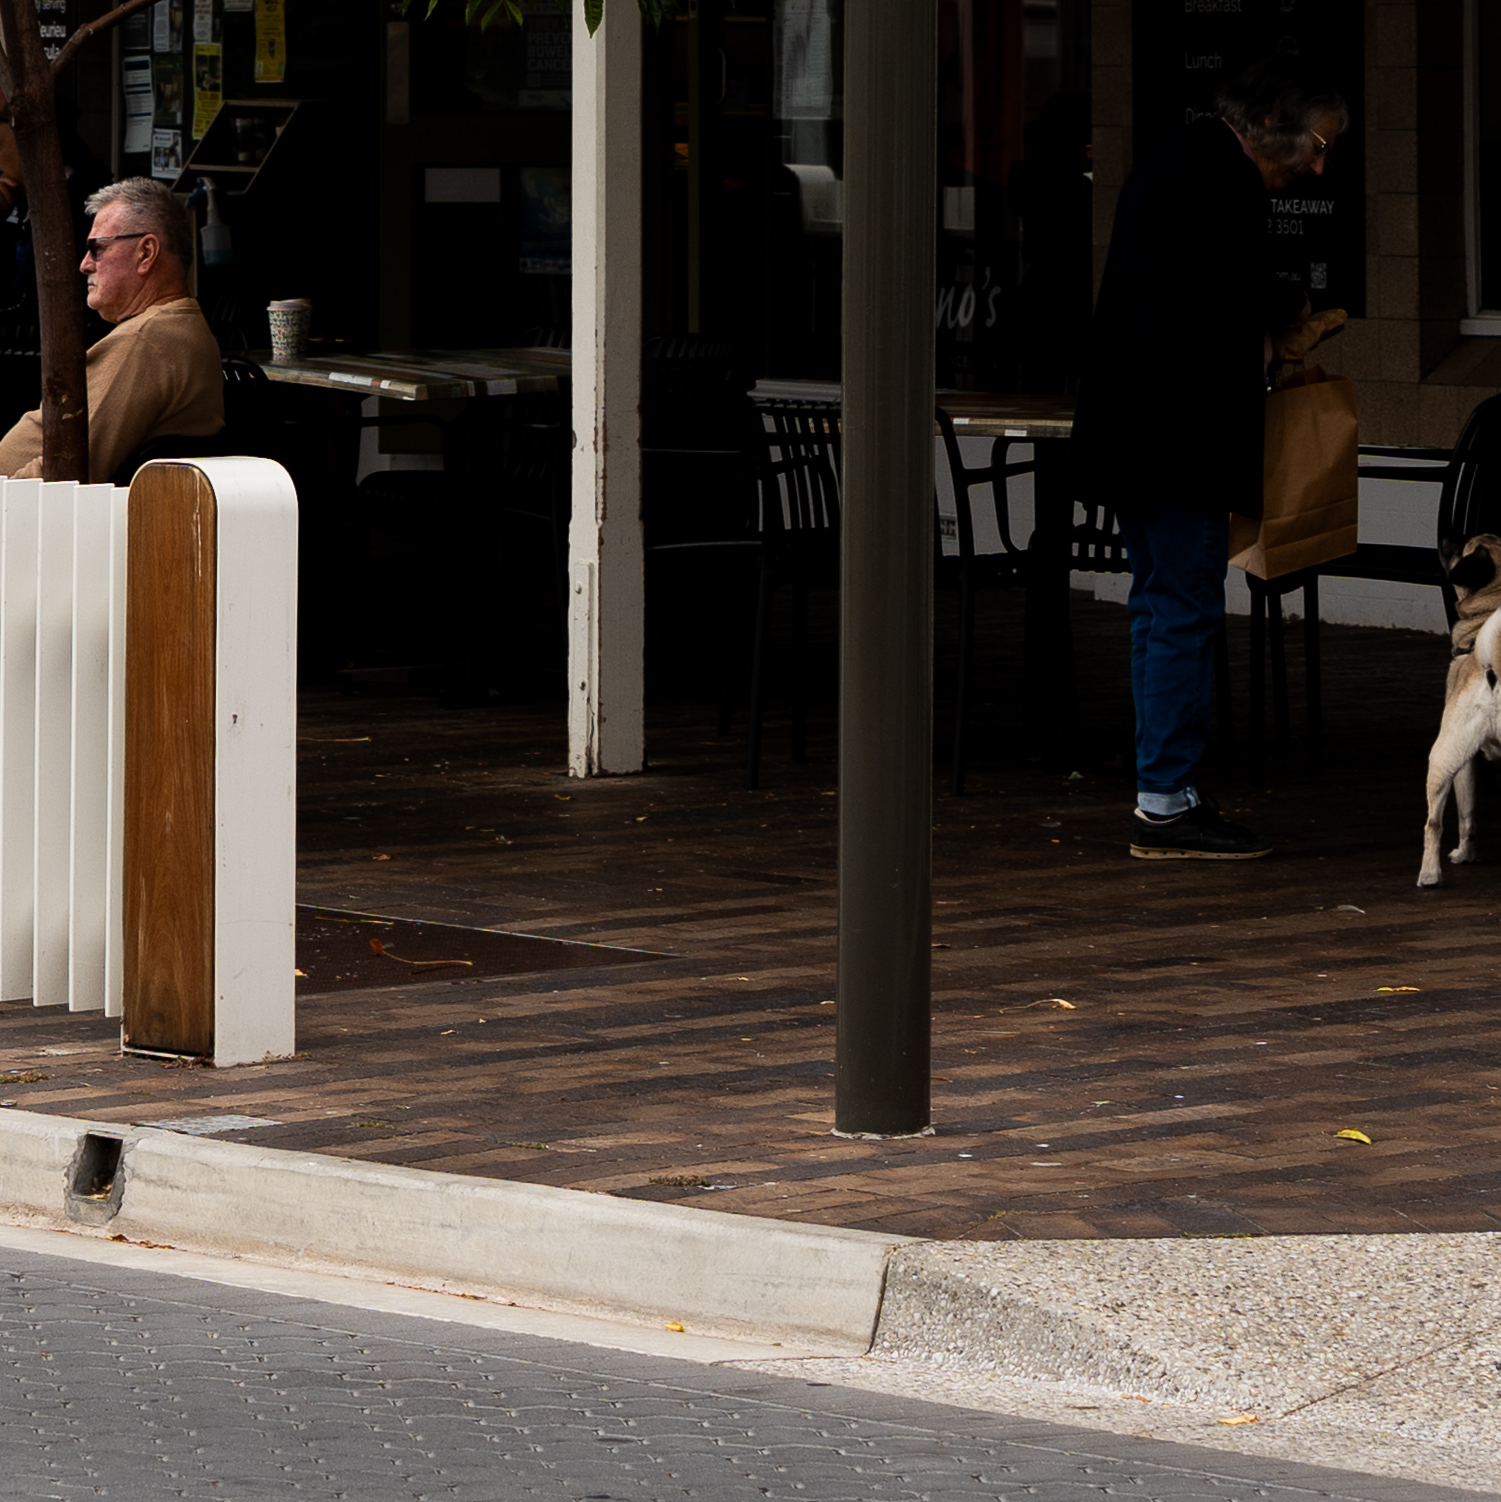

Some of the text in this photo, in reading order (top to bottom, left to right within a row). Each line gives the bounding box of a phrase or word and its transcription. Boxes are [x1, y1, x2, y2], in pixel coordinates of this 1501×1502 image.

[527, 46, 572, 58] BOWEL
[1184, 52, 1223, 70] Lunch
[527, 59, 572, 72] CANCE
[1269, 198, 1336, 216] TAKEAWAY
[1275, 218, 1304, 236] 3501
